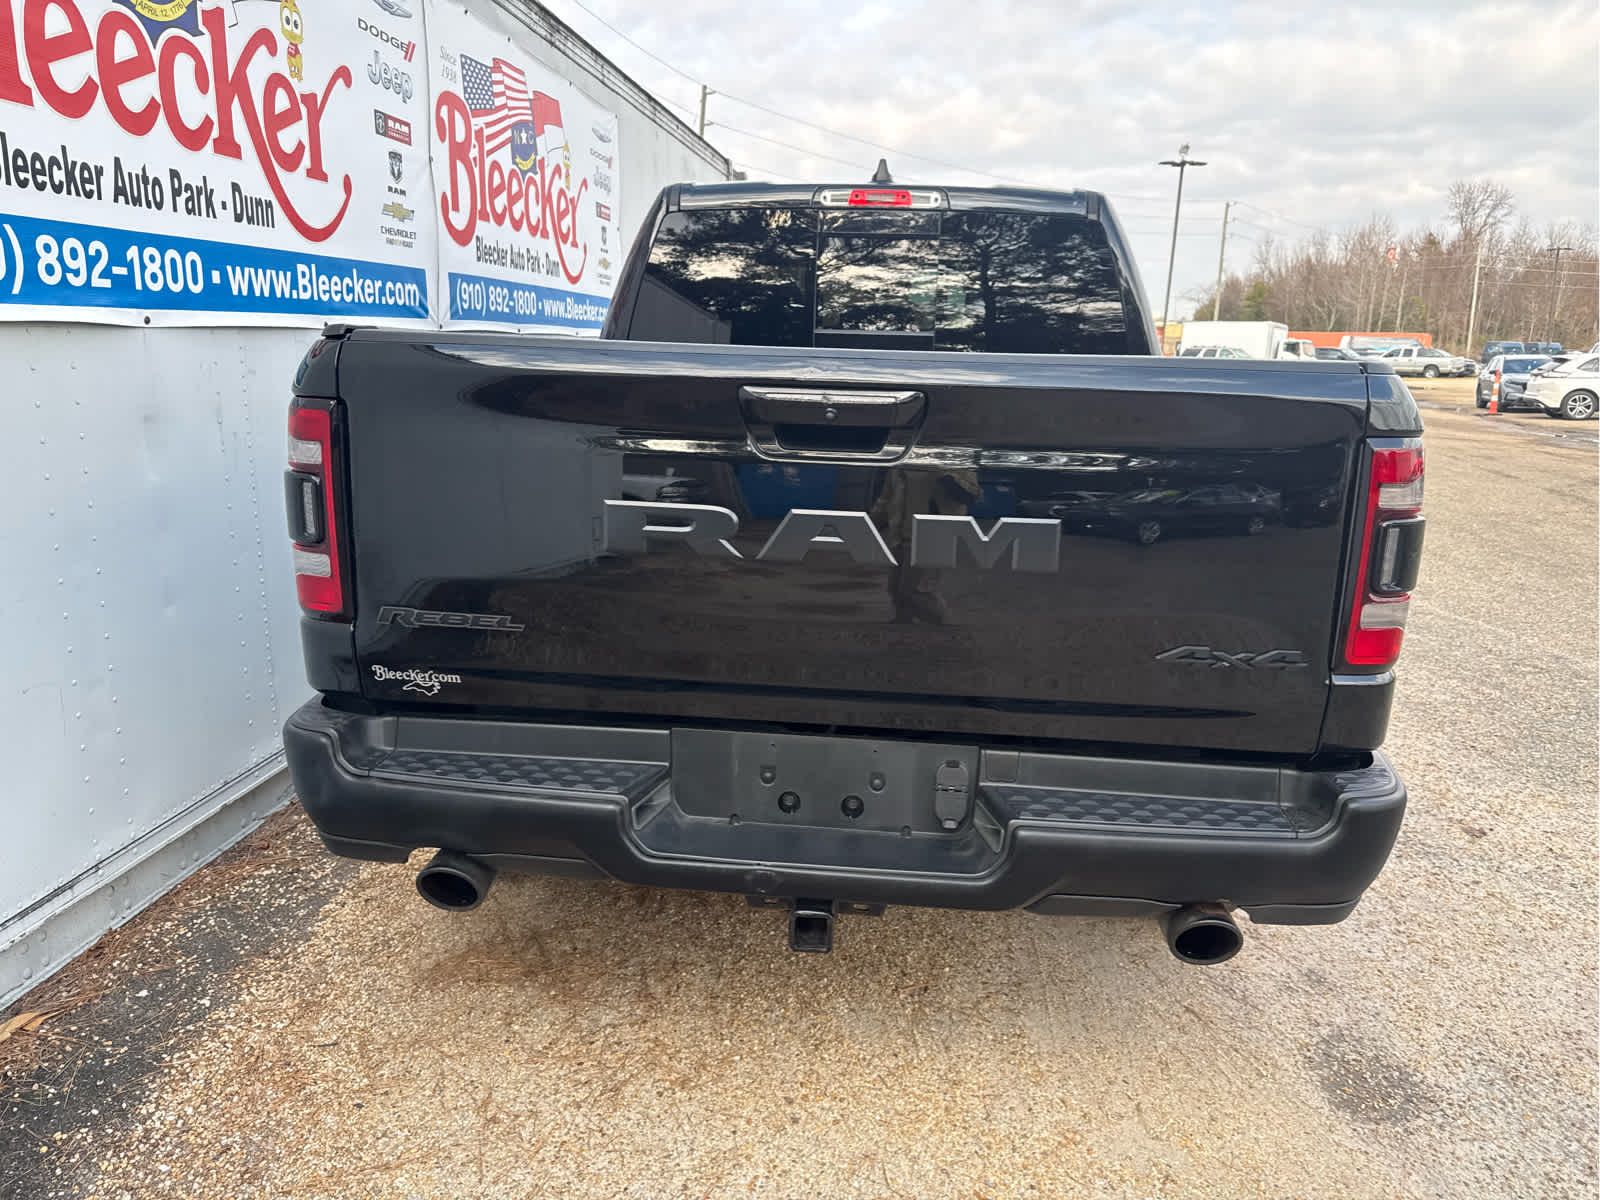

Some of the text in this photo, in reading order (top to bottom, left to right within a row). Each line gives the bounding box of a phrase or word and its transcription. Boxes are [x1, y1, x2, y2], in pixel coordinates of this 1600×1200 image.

[357, 17, 409, 54] DODGE
[367, 49, 414, 104] Jeep
[388, 119, 409, 134] RAM
[113, 156, 164, 211] Auto
[169, 168, 217, 219] Park
[231, 181, 275, 229] Dunn
[387, 185, 406, 196] RAM
[436, 91, 588, 285] Bleecker
[380, 225, 416, 239] CHEVROLET
[35, 234, 204, 294] 892-1800
[226, 263, 419, 306] www.Bleecker.com
[476, 235, 508, 269] Bleecker
[510, 244, 525, 271] Auto
[527, 247, 542, 275] Park
[457, 278, 486, 316] (910)
[489, 285, 537, 316] 892-1800
[603, 498, 1062, 573] RAM
[376, 605, 526, 632] REBEL
